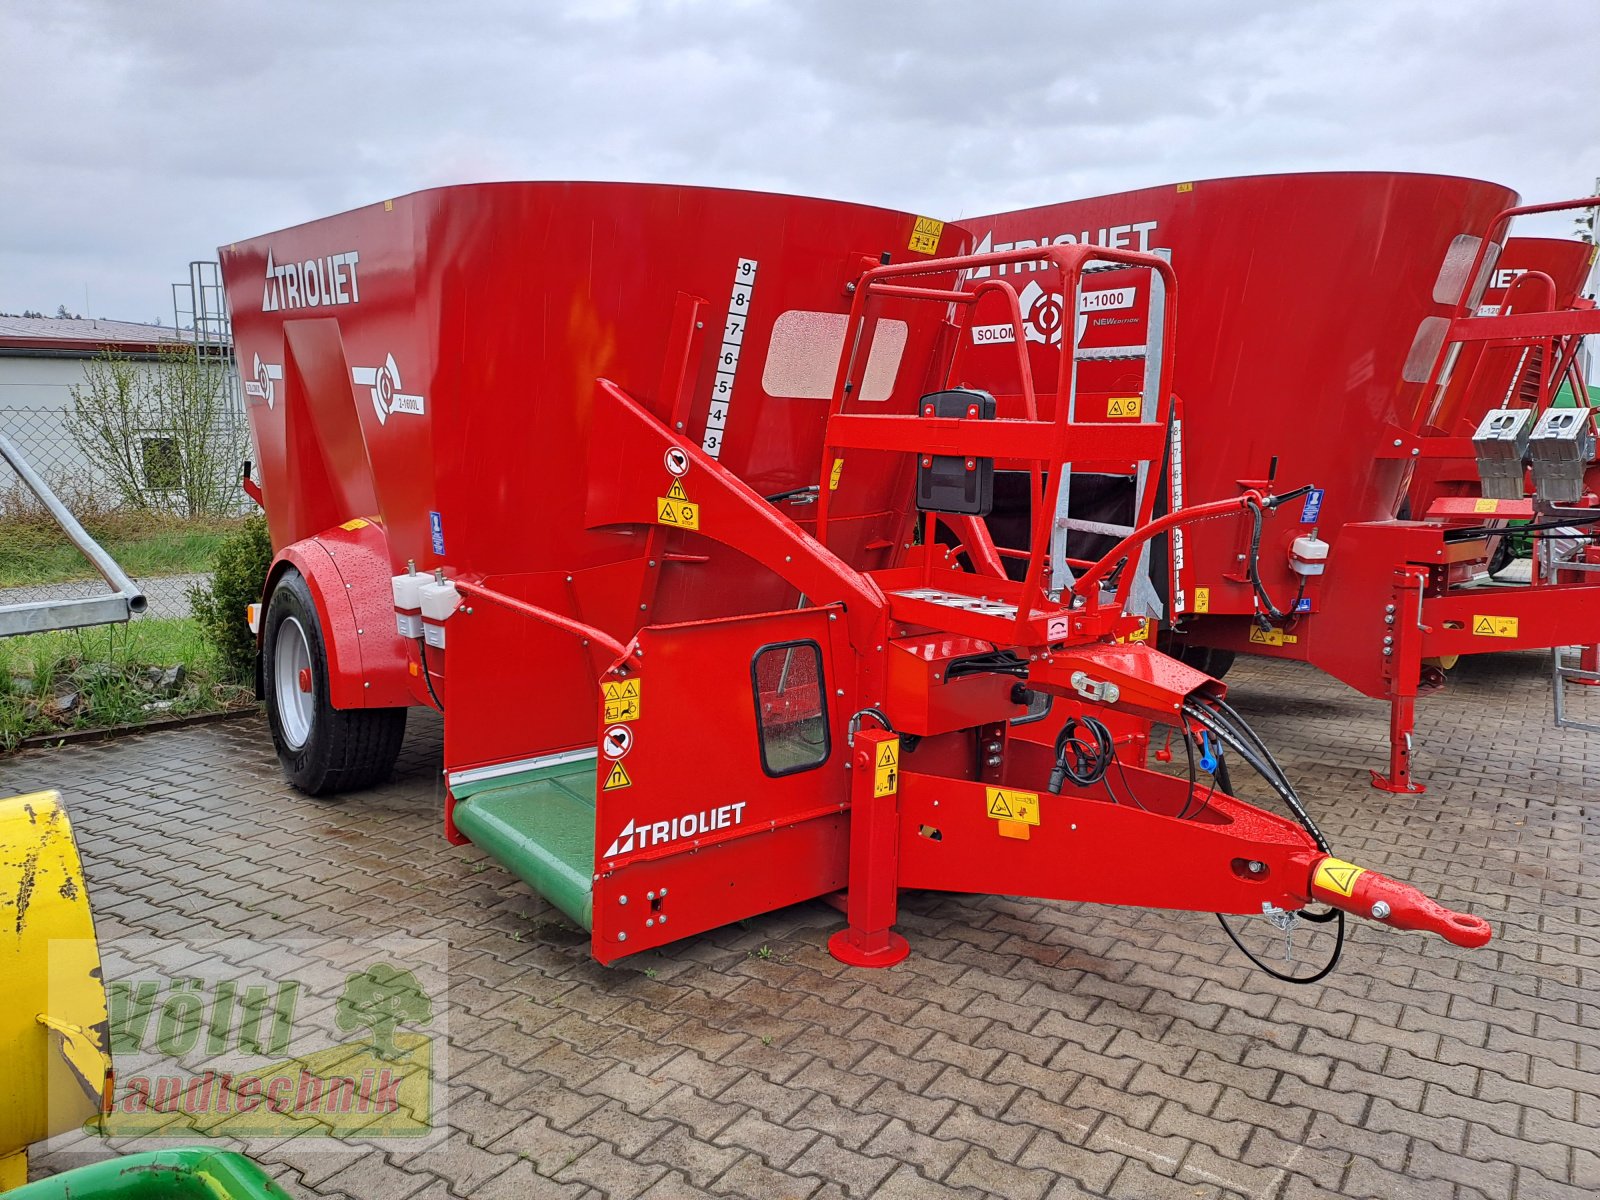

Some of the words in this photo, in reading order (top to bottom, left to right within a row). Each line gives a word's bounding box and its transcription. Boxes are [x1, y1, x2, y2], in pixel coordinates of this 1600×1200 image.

[741, 262, 752, 276] 9
[274, 250, 359, 310] TRIOLIET
[735, 293, 745, 306] 8
[1082, 292, 1124, 308] 1-1000
[730, 323, 740, 336] 7
[724, 352, 733, 365] 6
[718, 381, 728, 393] 5
[713, 409, 722, 422] 4
[707, 436, 717, 449] 3
[635, 801, 746, 849] TRIOLIET
